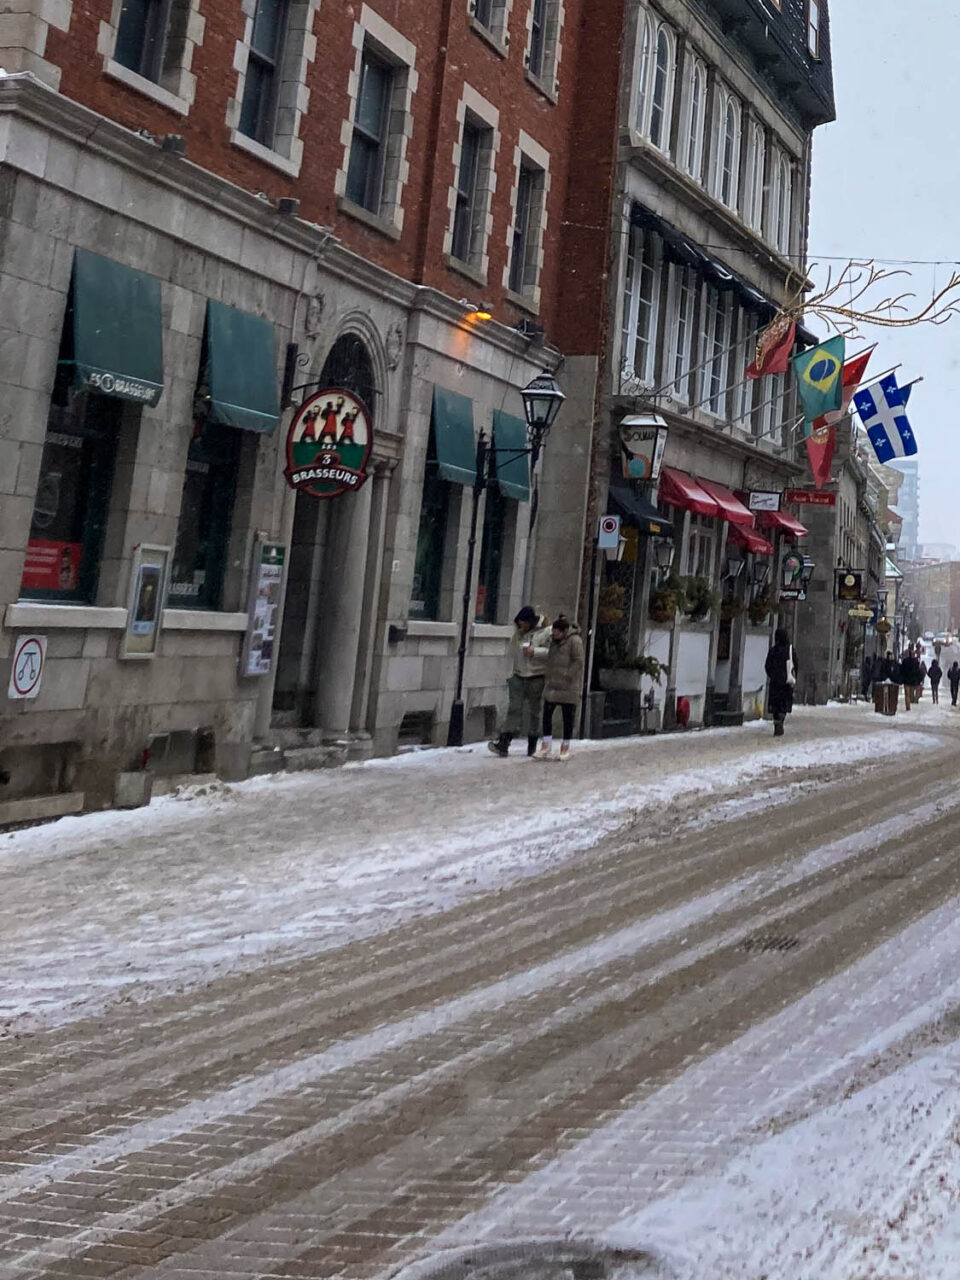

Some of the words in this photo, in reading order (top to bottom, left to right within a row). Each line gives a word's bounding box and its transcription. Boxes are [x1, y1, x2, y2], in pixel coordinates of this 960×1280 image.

[321, 443, 337, 451] LES
[321, 454, 332, 465] 3
[292, 468, 359, 485] BRASSEURS
